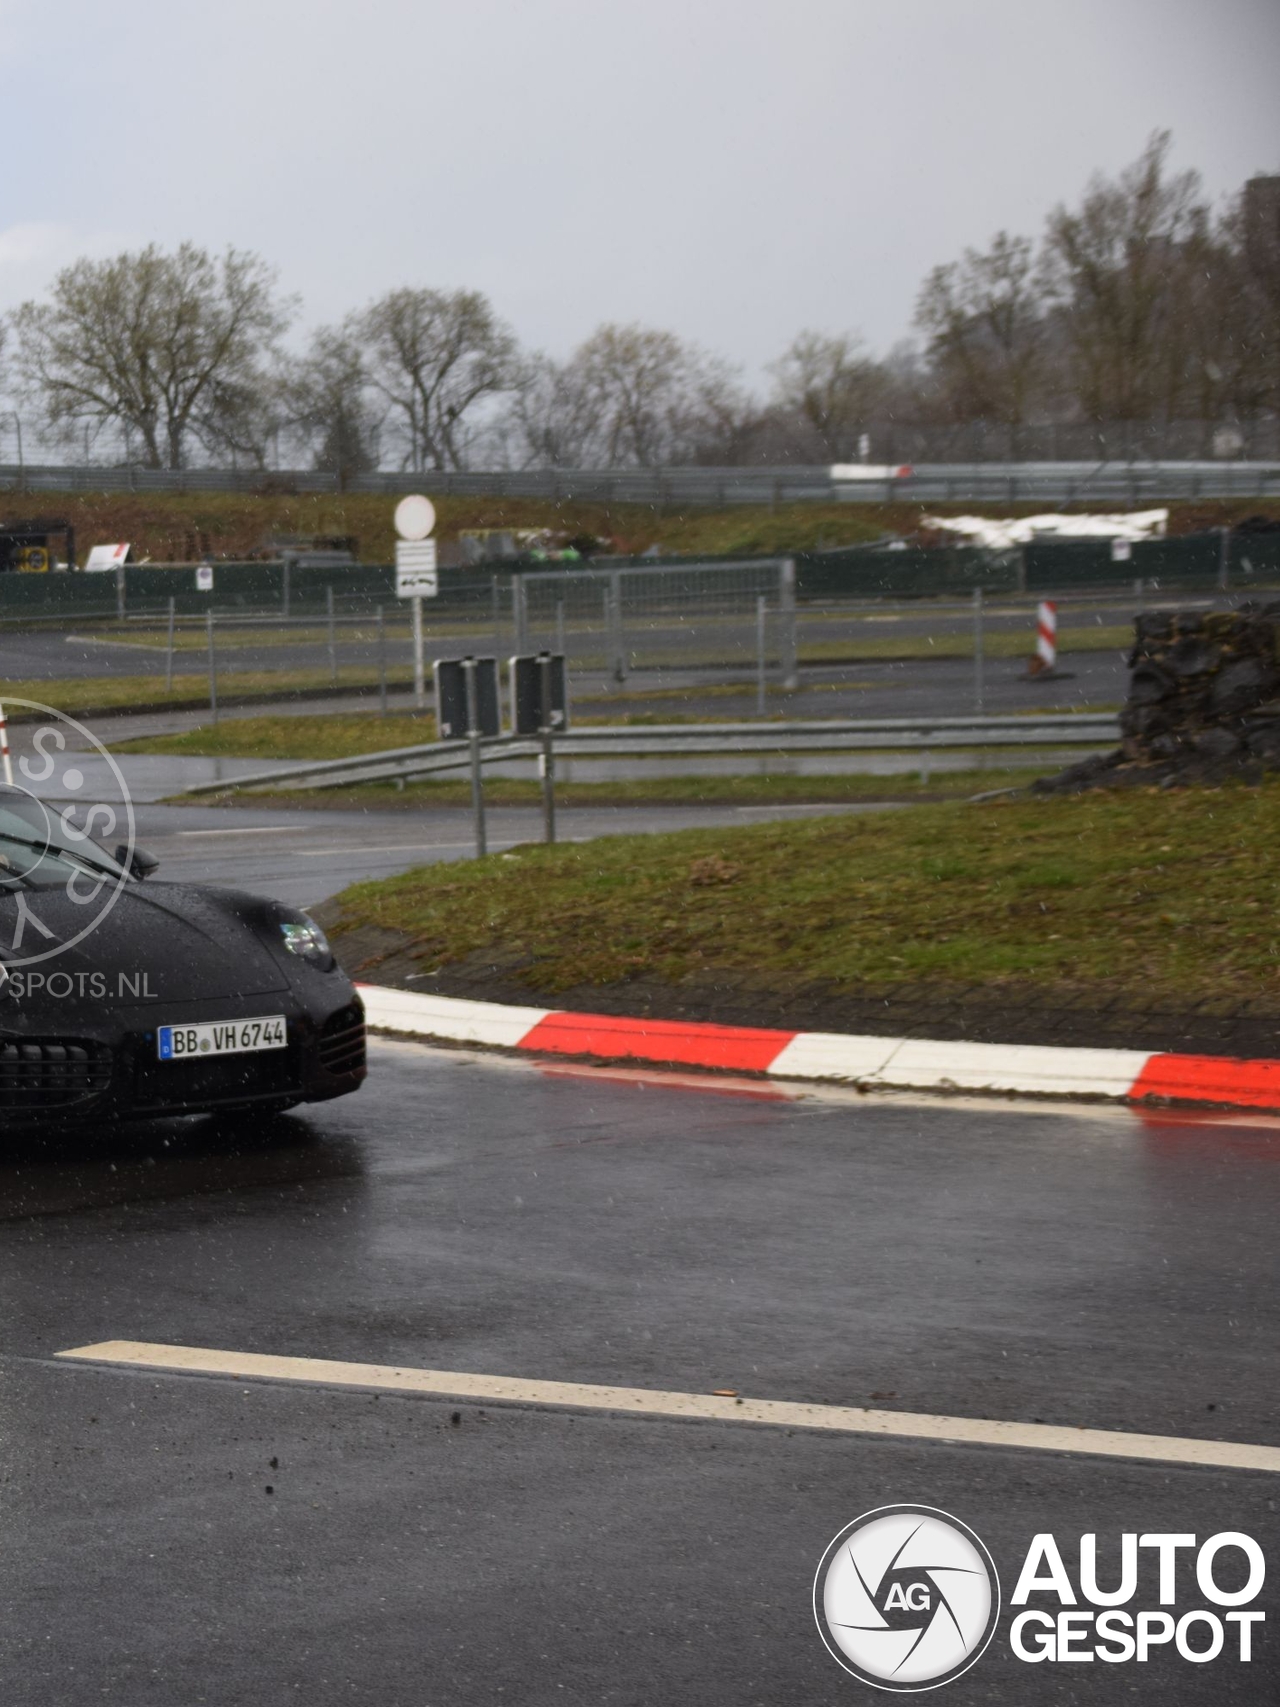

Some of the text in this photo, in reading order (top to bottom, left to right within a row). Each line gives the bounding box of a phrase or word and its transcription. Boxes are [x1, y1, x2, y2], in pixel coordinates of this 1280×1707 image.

[173, 1021, 284, 1053] BB VH 6744
